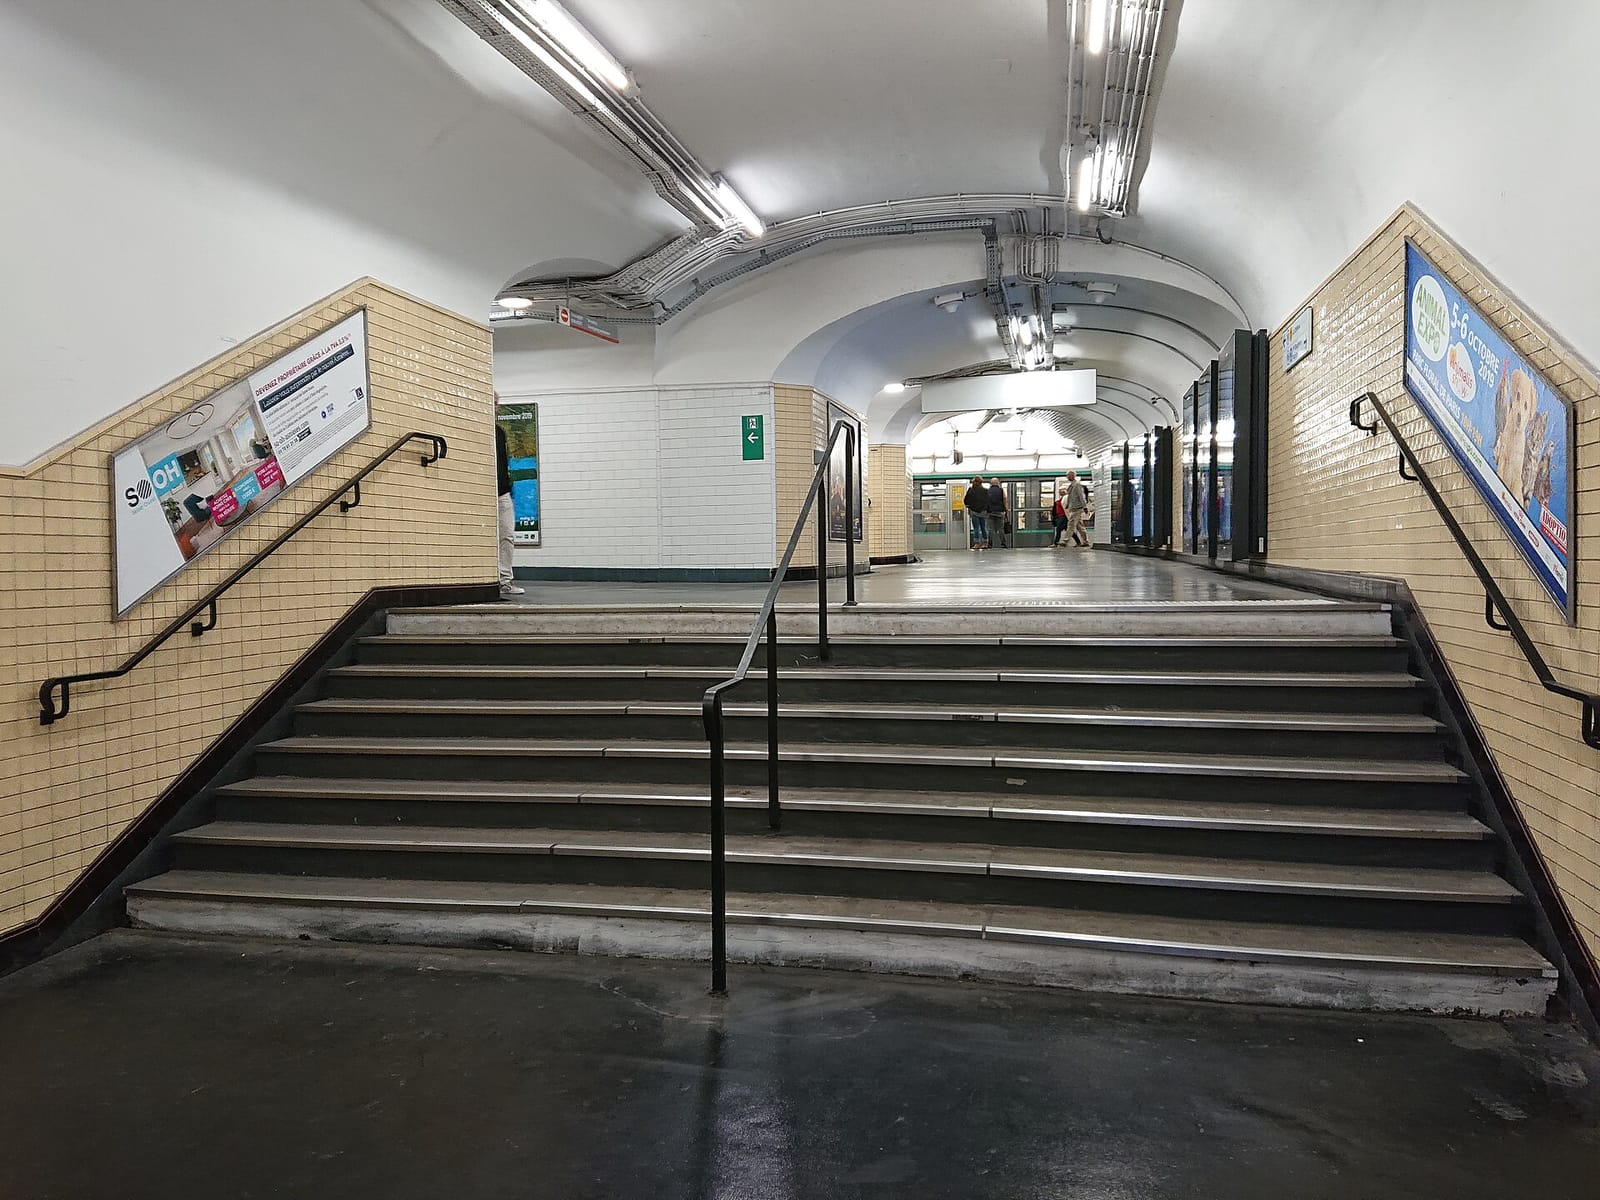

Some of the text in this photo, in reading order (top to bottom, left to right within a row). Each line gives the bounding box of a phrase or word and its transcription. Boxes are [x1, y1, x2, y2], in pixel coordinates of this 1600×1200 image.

[1416, 284, 1446, 336] ANIMAL
[1418, 311, 1440, 354] EXPO
[1451, 302, 1499, 375] 5-6 OCTOBRE
[255, 379, 278, 397] DEVENEZ
[1479, 360, 1495, 388] 2019
[152, 460, 181, 489] OH
[1542, 510, 1567, 546] ADOPTIO
